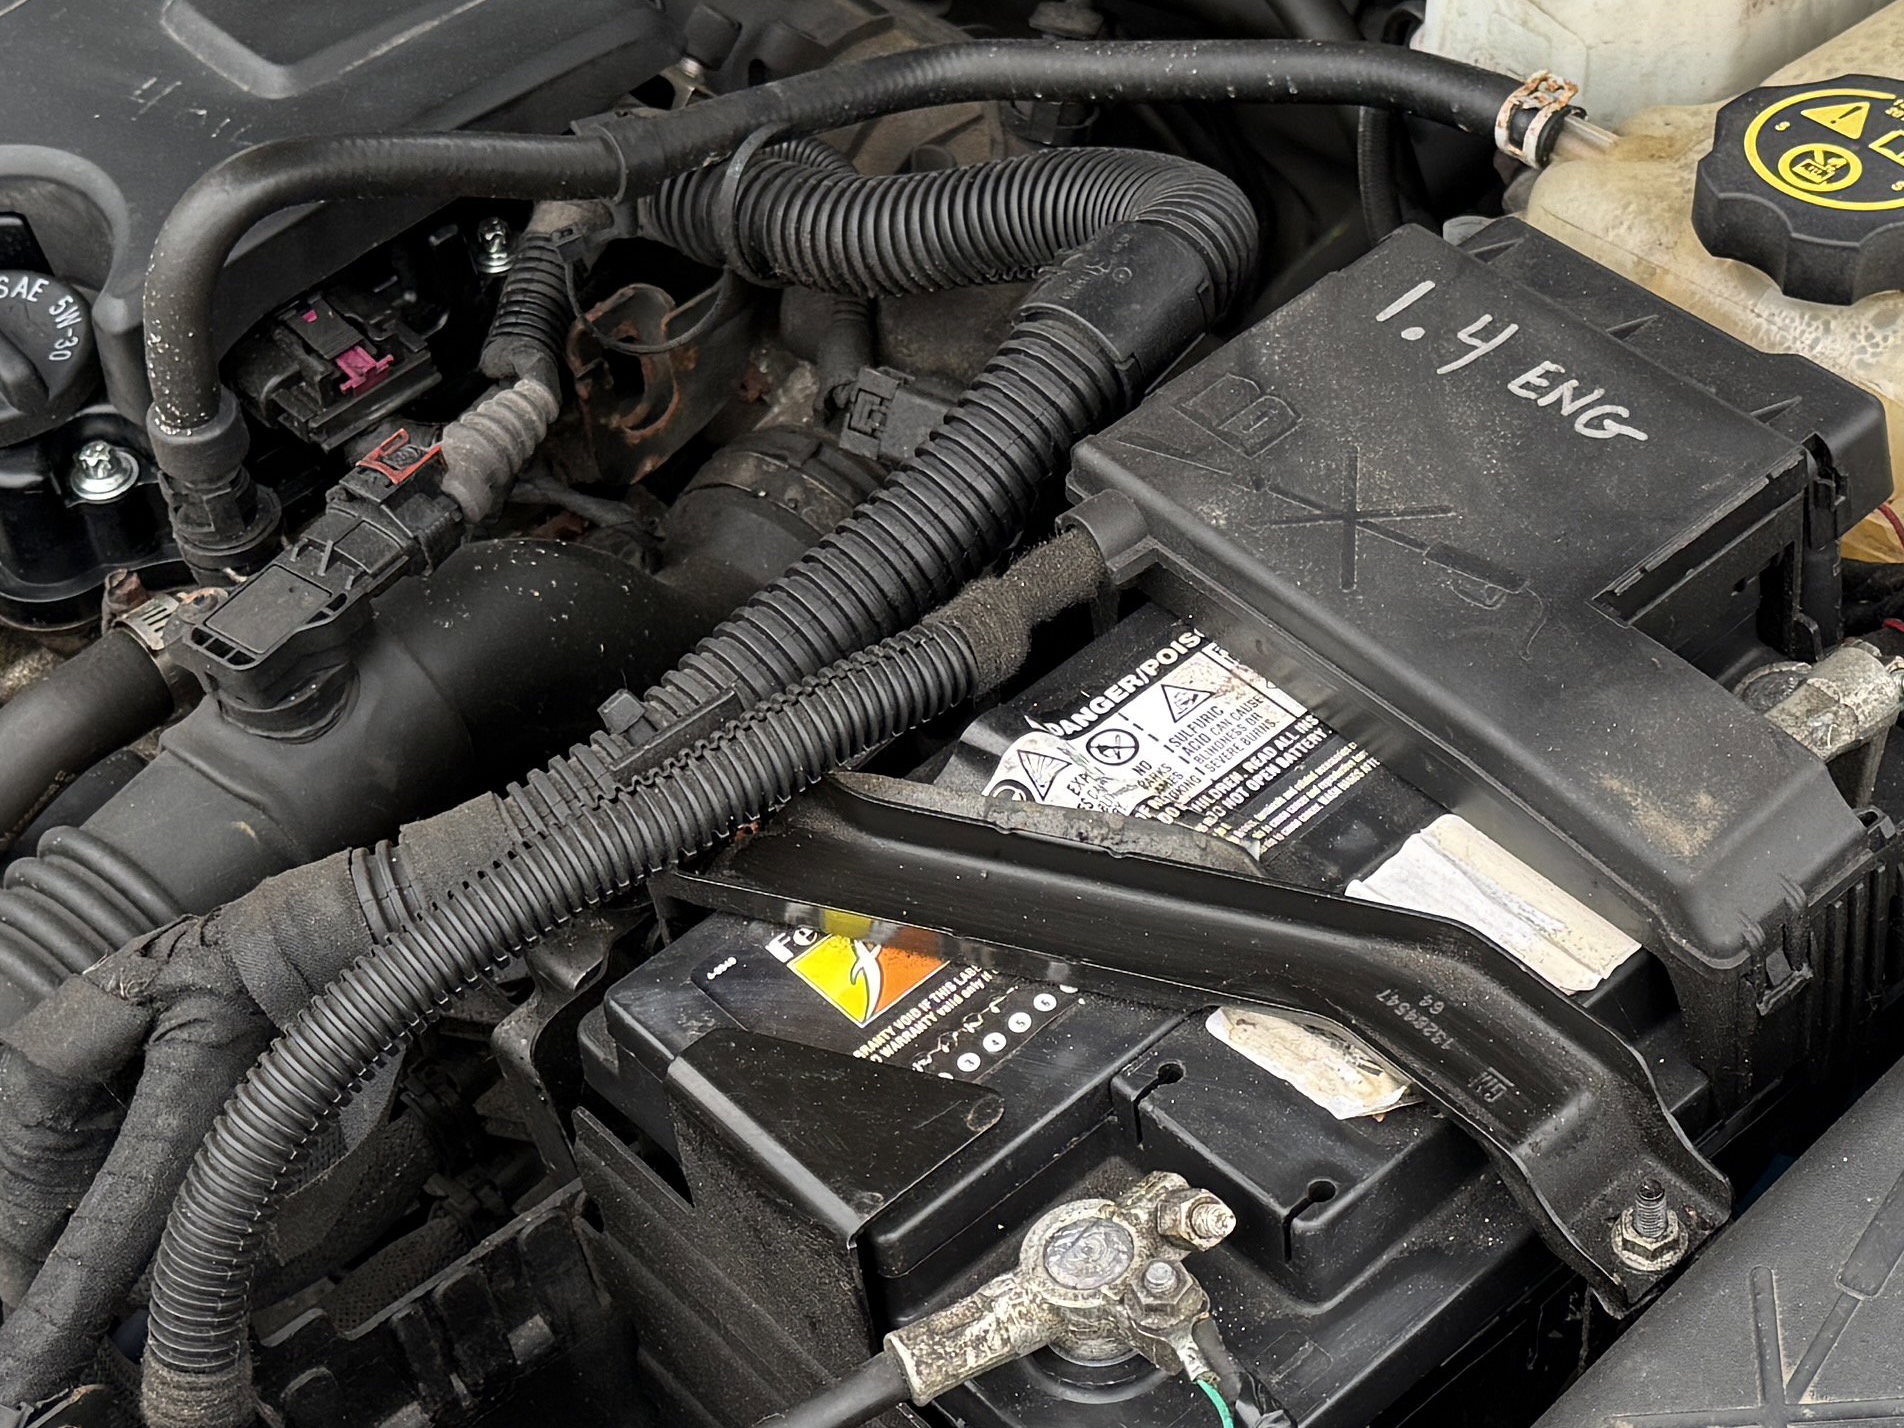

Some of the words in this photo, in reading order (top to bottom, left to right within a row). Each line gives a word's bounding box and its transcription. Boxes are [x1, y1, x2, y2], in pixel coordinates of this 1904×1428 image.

[45, 294, 81, 365] 5W-30
[1373, 279, 1521, 377] 1.4
[1507, 361, 1650, 442] ENG
[1170, 706, 1224, 747] SULFURIC
[1183, 732, 1211, 756] ACID
[1210, 718, 1230, 735] CAN
[1230, 694, 1264, 721] CAUSE
[1248, 712, 1262, 725] OR
[1132, 760, 1151, 775] NO
[1205, 743, 1242, 772] SEVERE
[1244, 746, 1277, 771] READ
[1275, 728, 1301, 749] ALL
[1224, 787, 1249, 807] NOT
[1248, 763, 1281, 789] OPEN
[880, 1012, 938, 1059] WARRANTY
[935, 993, 964, 1017] valid
[961, 977, 985, 998] only
[895, 1006, 922, 1029] VOID
[929, 980, 957, 1004] THIS
